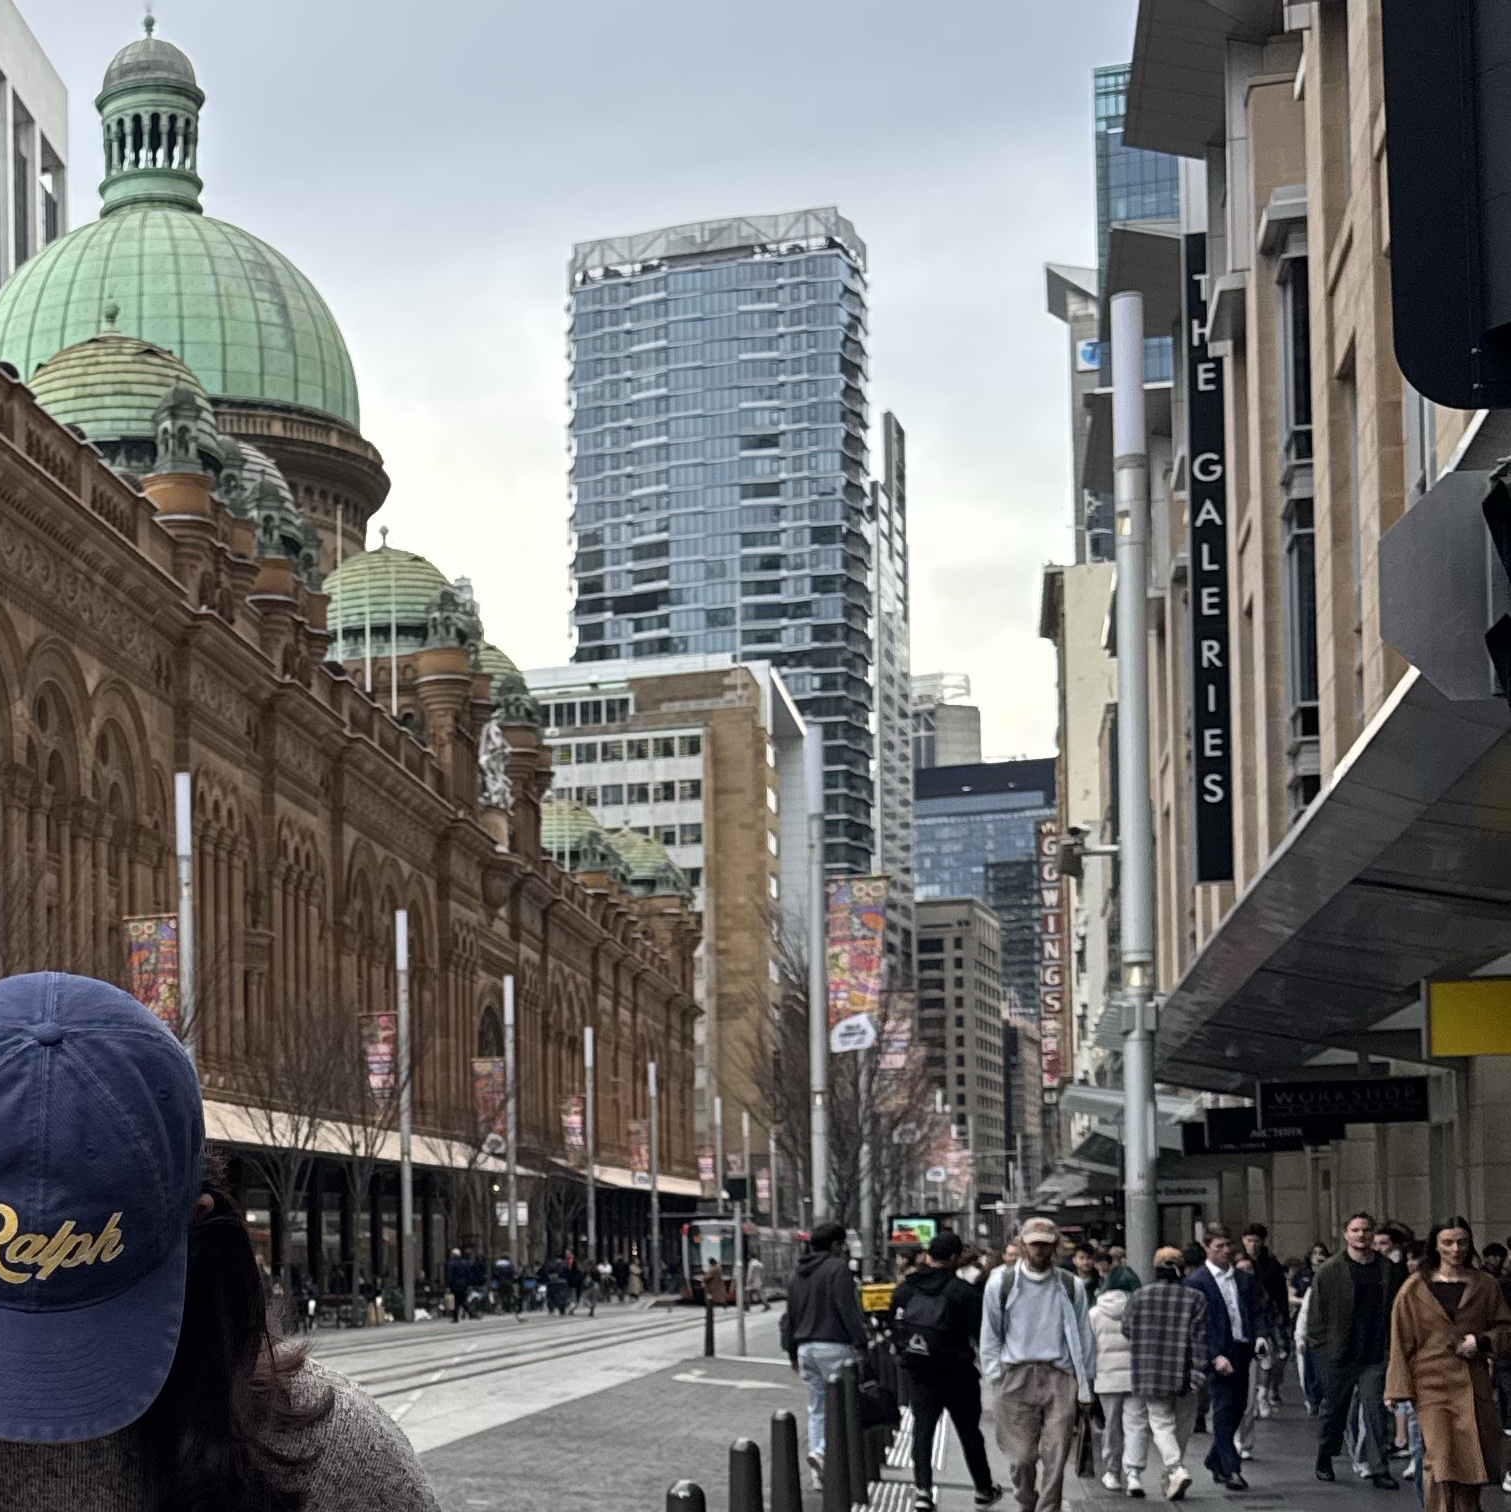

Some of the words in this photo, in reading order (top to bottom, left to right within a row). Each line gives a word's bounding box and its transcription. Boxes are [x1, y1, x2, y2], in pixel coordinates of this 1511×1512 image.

[1191, 274, 1217, 391] THE
[1192, 452, 1224, 803] GALERIES
[1041, 835, 1062, 1011] GOWINGS
[1274, 1085, 1416, 1104] WORKSHOP
